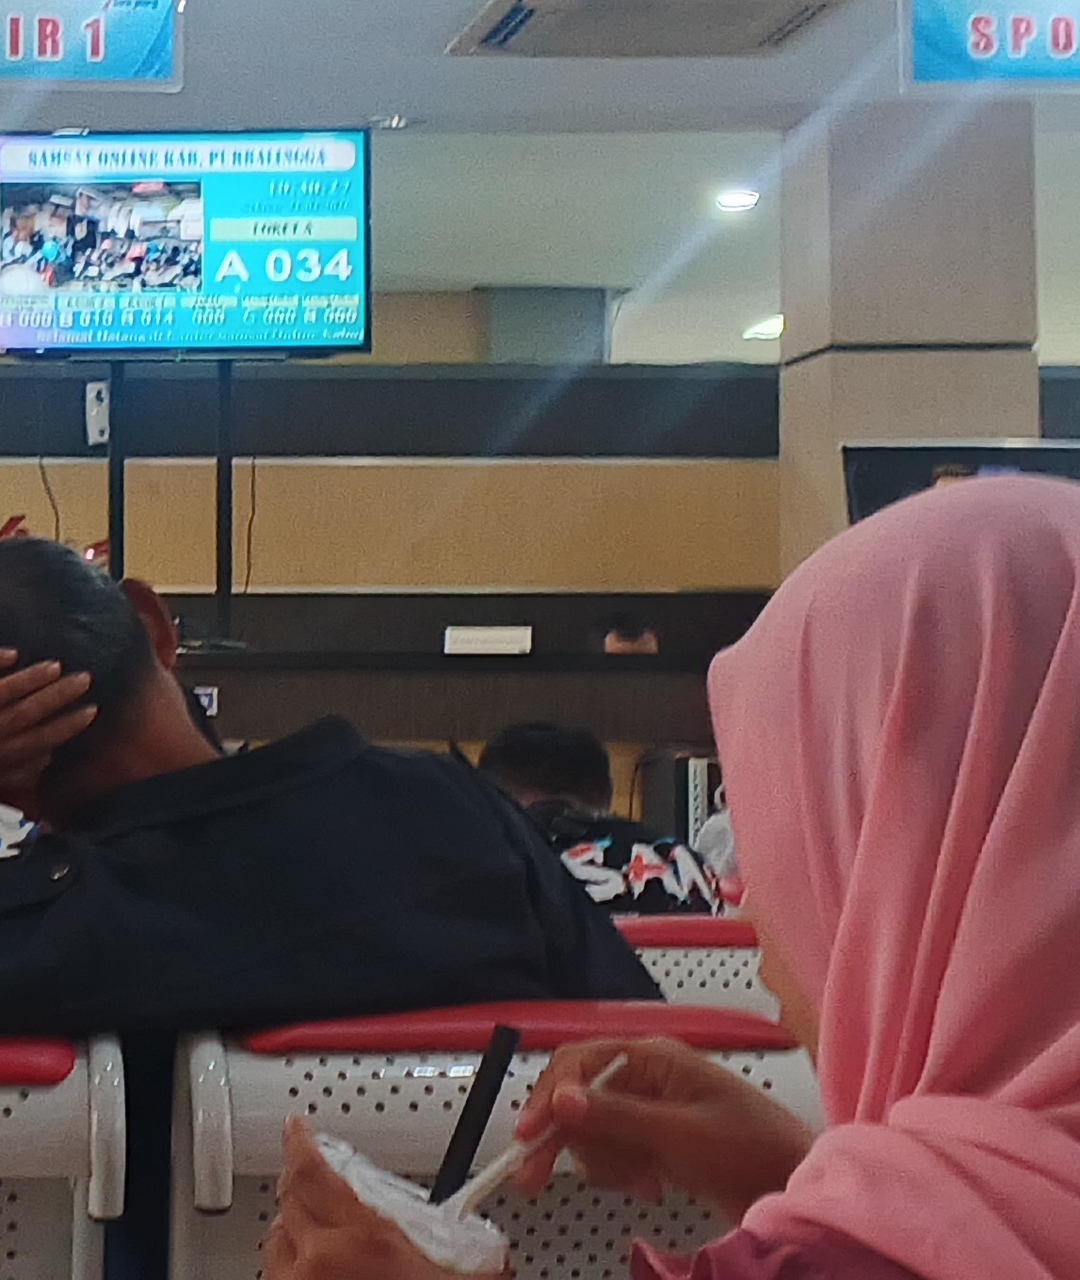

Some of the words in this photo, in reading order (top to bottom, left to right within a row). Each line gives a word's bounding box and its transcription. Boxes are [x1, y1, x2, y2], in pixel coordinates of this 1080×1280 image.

[82, 17, 107, 62] 1
[214, 250, 250, 282] A
[265, 248, 353, 282] 034
